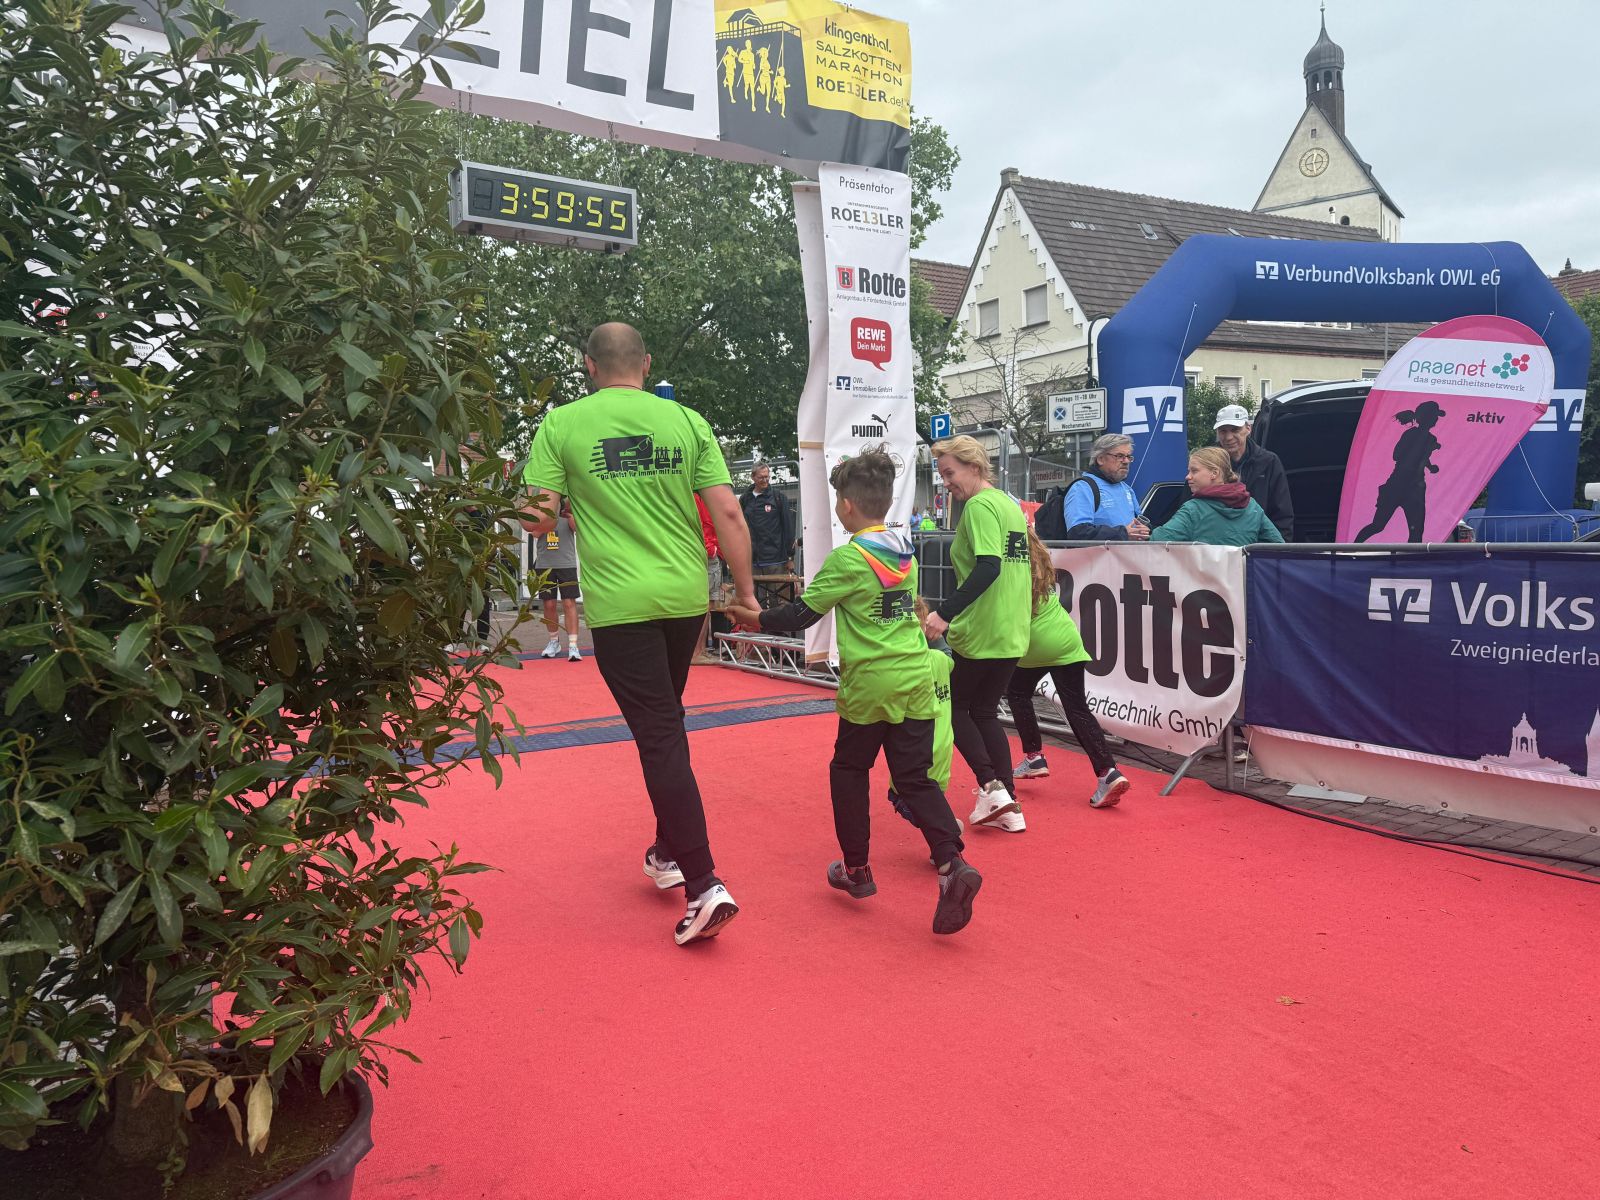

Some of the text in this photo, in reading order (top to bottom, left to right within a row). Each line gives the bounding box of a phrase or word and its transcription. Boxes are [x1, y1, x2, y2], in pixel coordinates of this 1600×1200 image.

[824, 17, 892, 54] klingenthal.
[816, 40, 902, 73] SALZKOTTEN
[816, 55, 903, 87] MARATHON
[839, 175, 895, 195] Präsentator
[500, 182, 627, 232] 3:59:55
[831, 206, 904, 230] ROE13LER
[858, 267, 906, 299] Rotte
[1284, 263, 1501, 286] VerbundVolksbank OWL eG
[857, 327, 886, 342] REWE
[857, 341, 886, 352] Dein Markt
[1413, 376, 1525, 392] das gesundheitsnetzwerk
[935, 418, 946, 438] P
[1061, 422, 1092, 430] Wochenmarkt
[1466, 411, 1506, 424] aktiv
[851, 425, 883, 437] PUMA
[1450, 580, 1596, 631] Volks
[1450, 639, 1600, 666] Zweigniederla
